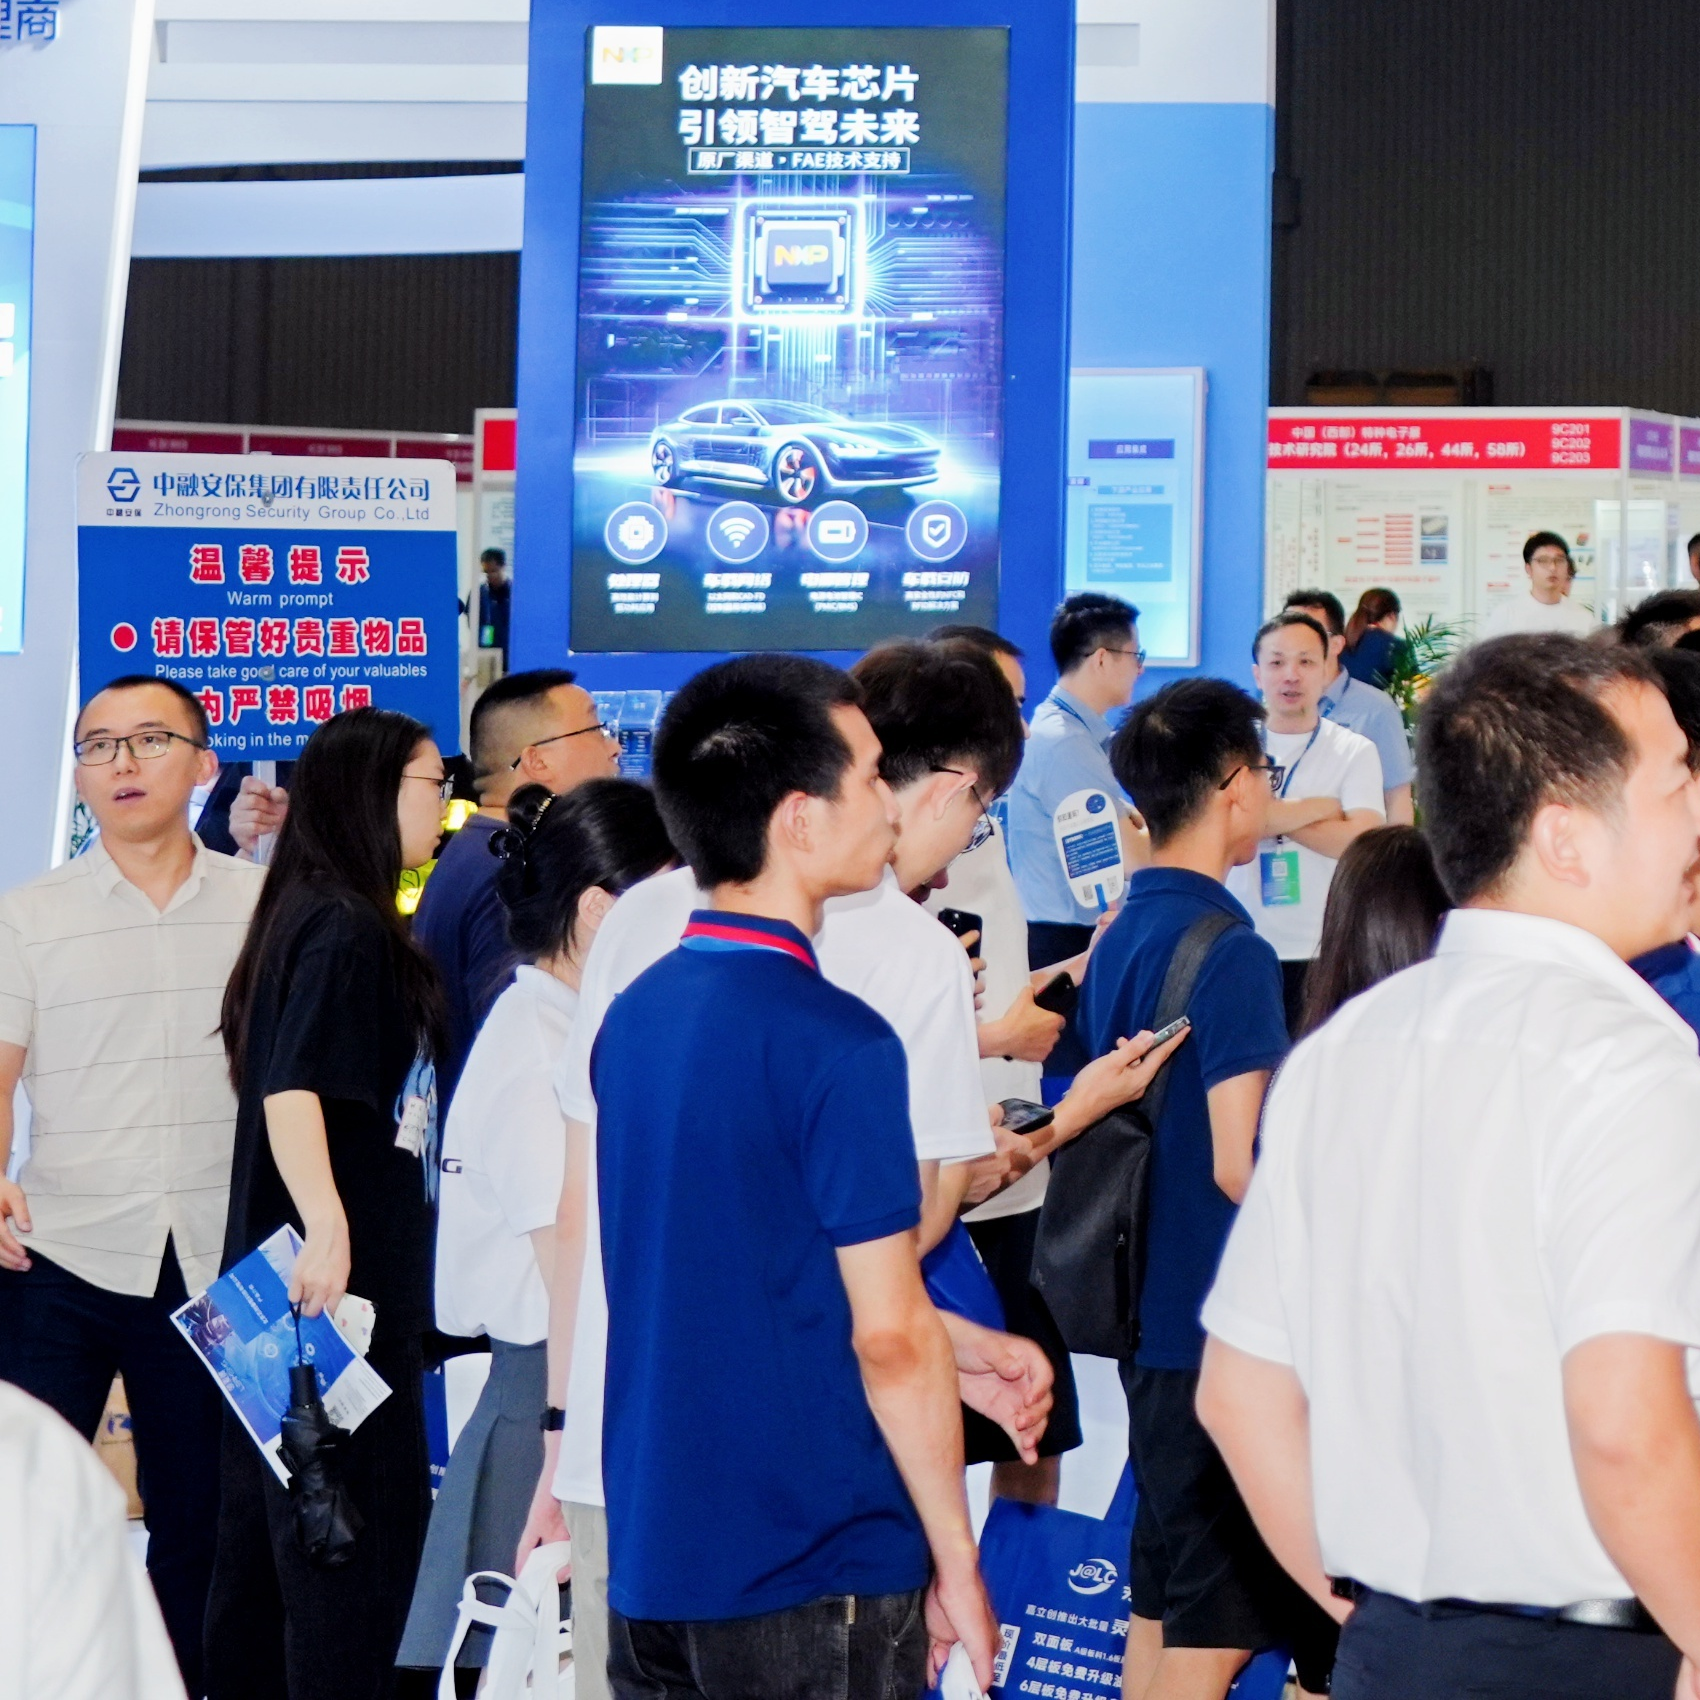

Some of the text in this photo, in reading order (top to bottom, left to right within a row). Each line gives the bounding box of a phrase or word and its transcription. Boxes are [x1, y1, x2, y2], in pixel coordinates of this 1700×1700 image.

[678, 65, 920, 102] 创新汽车芯片
[678, 109, 921, 145] 引领智驾未来
[773, 245, 829, 267] NXP
[153, 472, 431, 502] 中融安保集团有限责任公司
[154, 502, 242, 521] Zhongrong
[246, 504, 311, 523] Security
[318, 506, 367, 523] Group
[190, 543, 371, 585] 温馨提示
[227, 591, 334, 609] Warm prompt
[151, 617, 428, 658] 请保管好贵重物品
[155, 663, 428, 682] Please take go care of your valuables
[251, 733, 264, 747] in
[268, 732, 292, 747] the
[1031, 1631, 1075, 1653] 双面板
